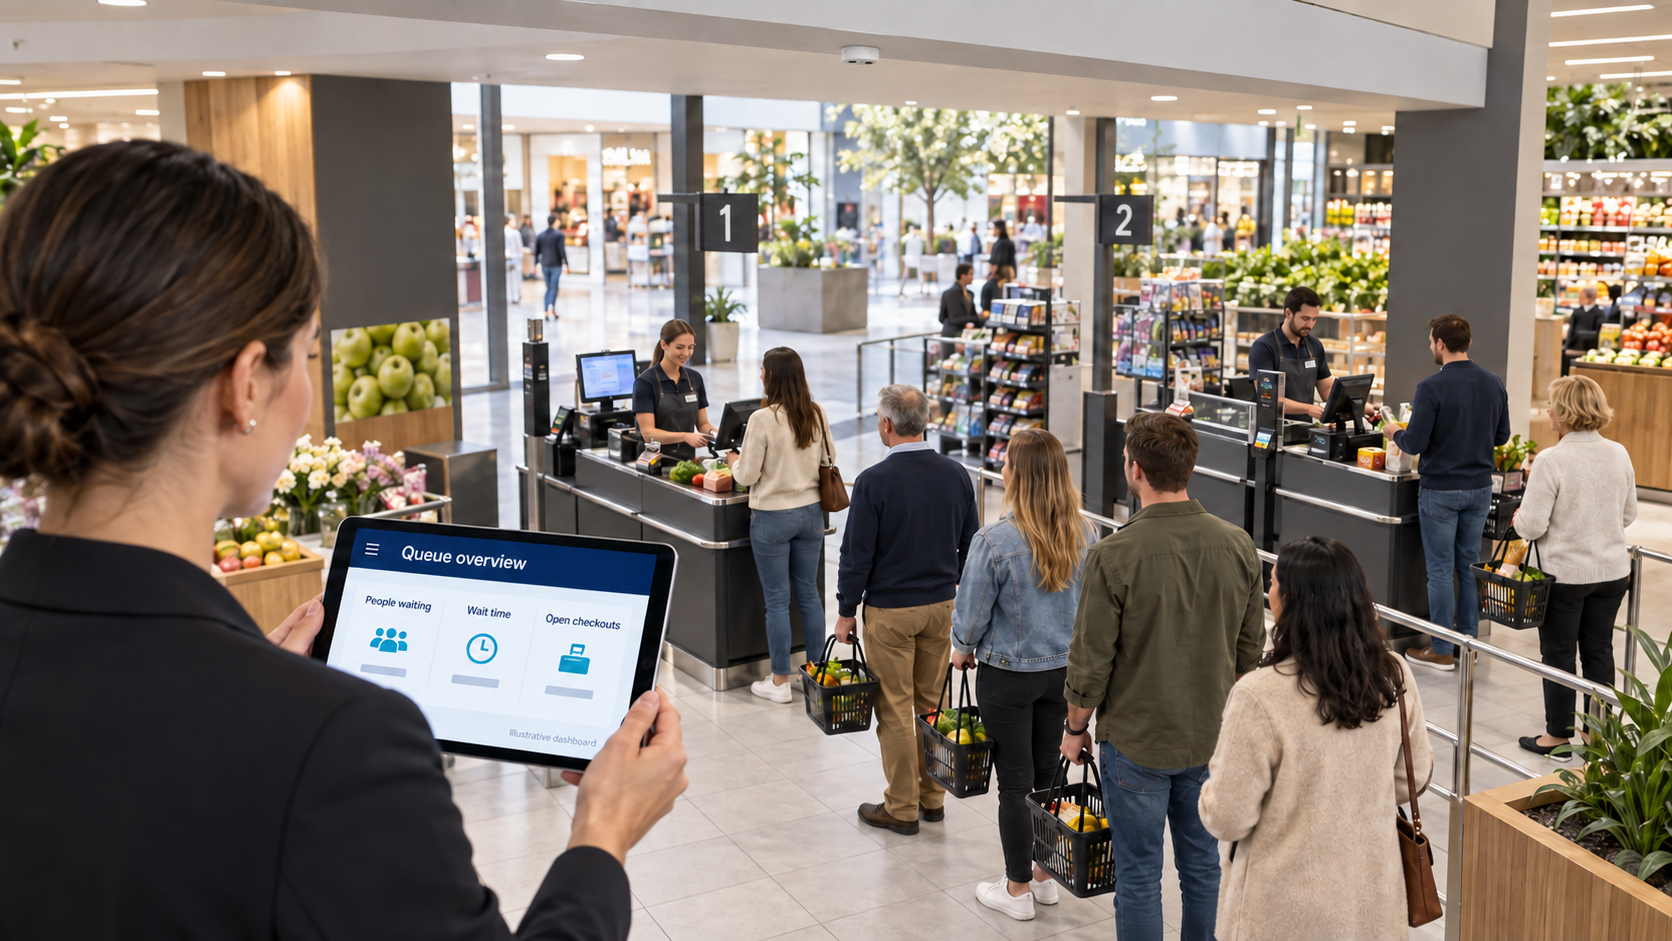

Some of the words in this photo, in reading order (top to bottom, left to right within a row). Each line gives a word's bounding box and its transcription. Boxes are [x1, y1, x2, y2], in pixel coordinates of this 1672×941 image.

[719, 204, 731, 242] 1
[1115, 203, 1133, 237] 2
[401, 545, 452, 565] Queue
[455, 552, 528, 571] overview
[365, 595, 397, 609] People
[398, 599, 432, 613] waiting
[467, 605, 489, 617] Wait
[490, 607, 512, 619] time
[545, 613, 572, 626] Open
[573, 616, 621, 630] checkouts
[509, 729, 551, 743] Illustrative
[552, 733, 597, 747] dashboard
